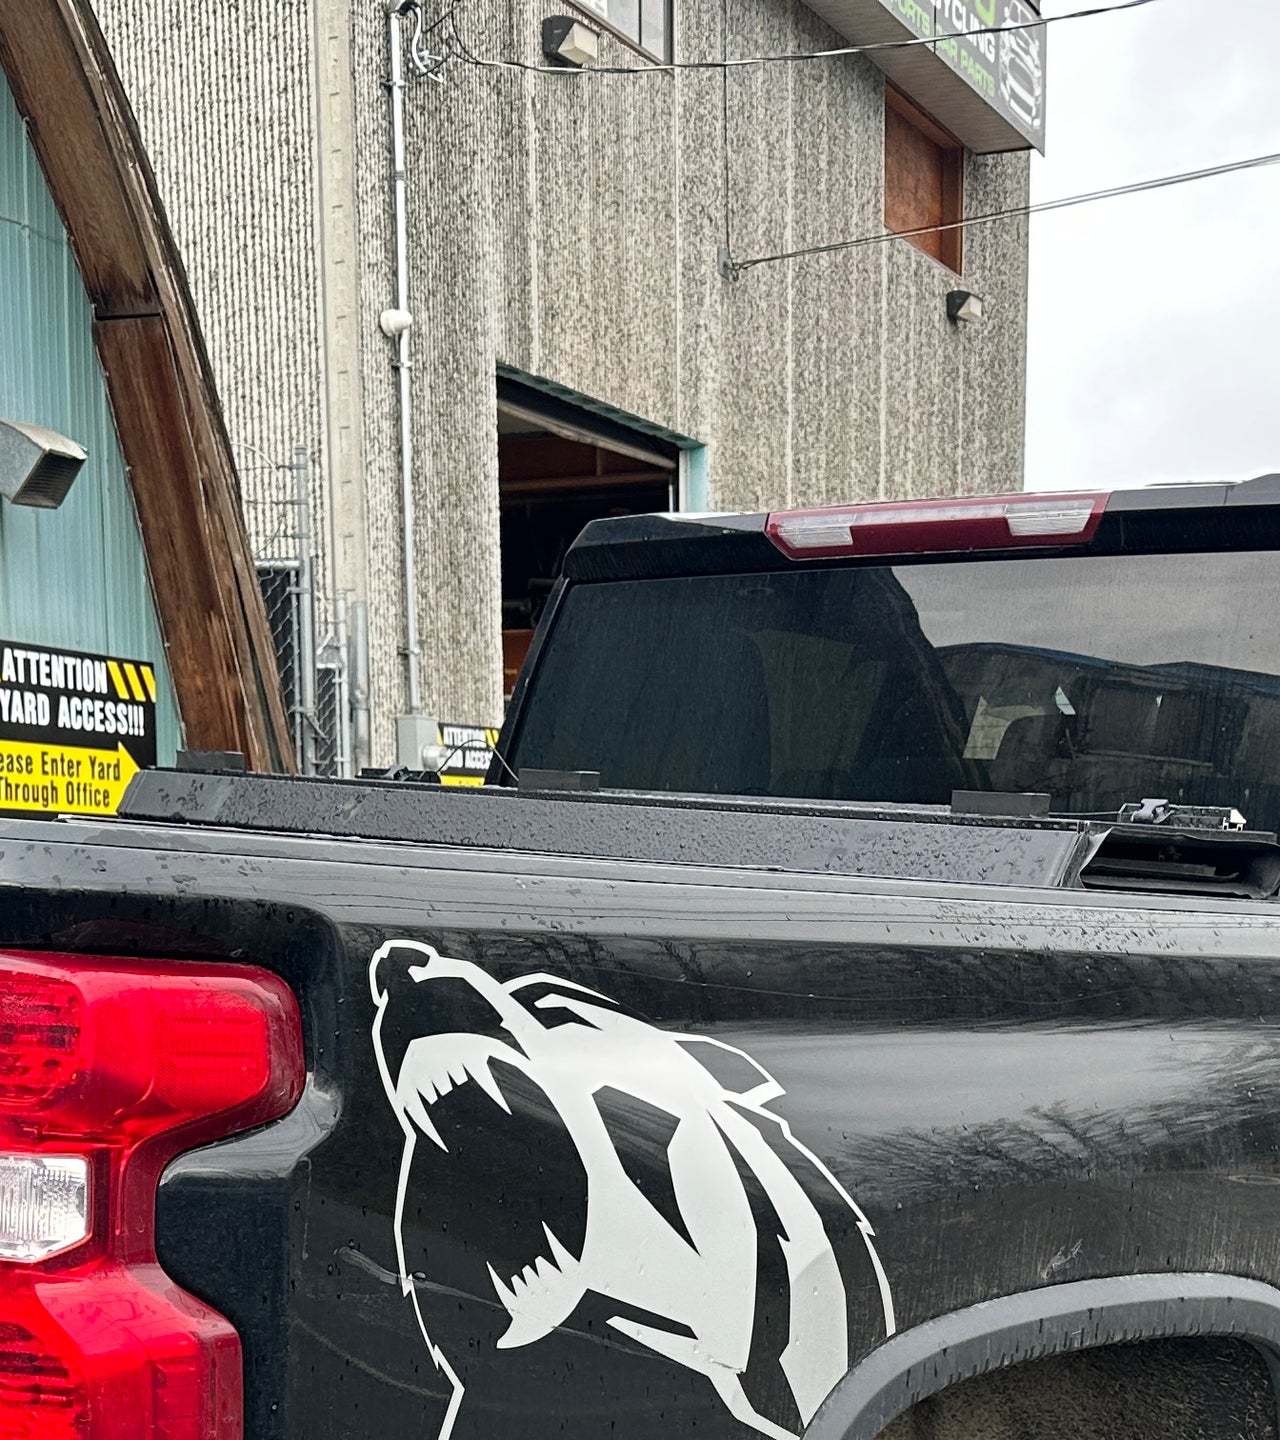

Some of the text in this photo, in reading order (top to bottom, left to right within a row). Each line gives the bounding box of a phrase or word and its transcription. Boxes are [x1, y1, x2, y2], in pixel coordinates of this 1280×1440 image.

[960, 50, 995, 98] PARTS
[1, 647, 108, 694] ATTENTION
[57, 696, 145, 737] ACCESS!!!
[41, 751, 82, 779] Enter
[88, 756, 121, 782] Yard
[65, 781, 111, 808] Office
